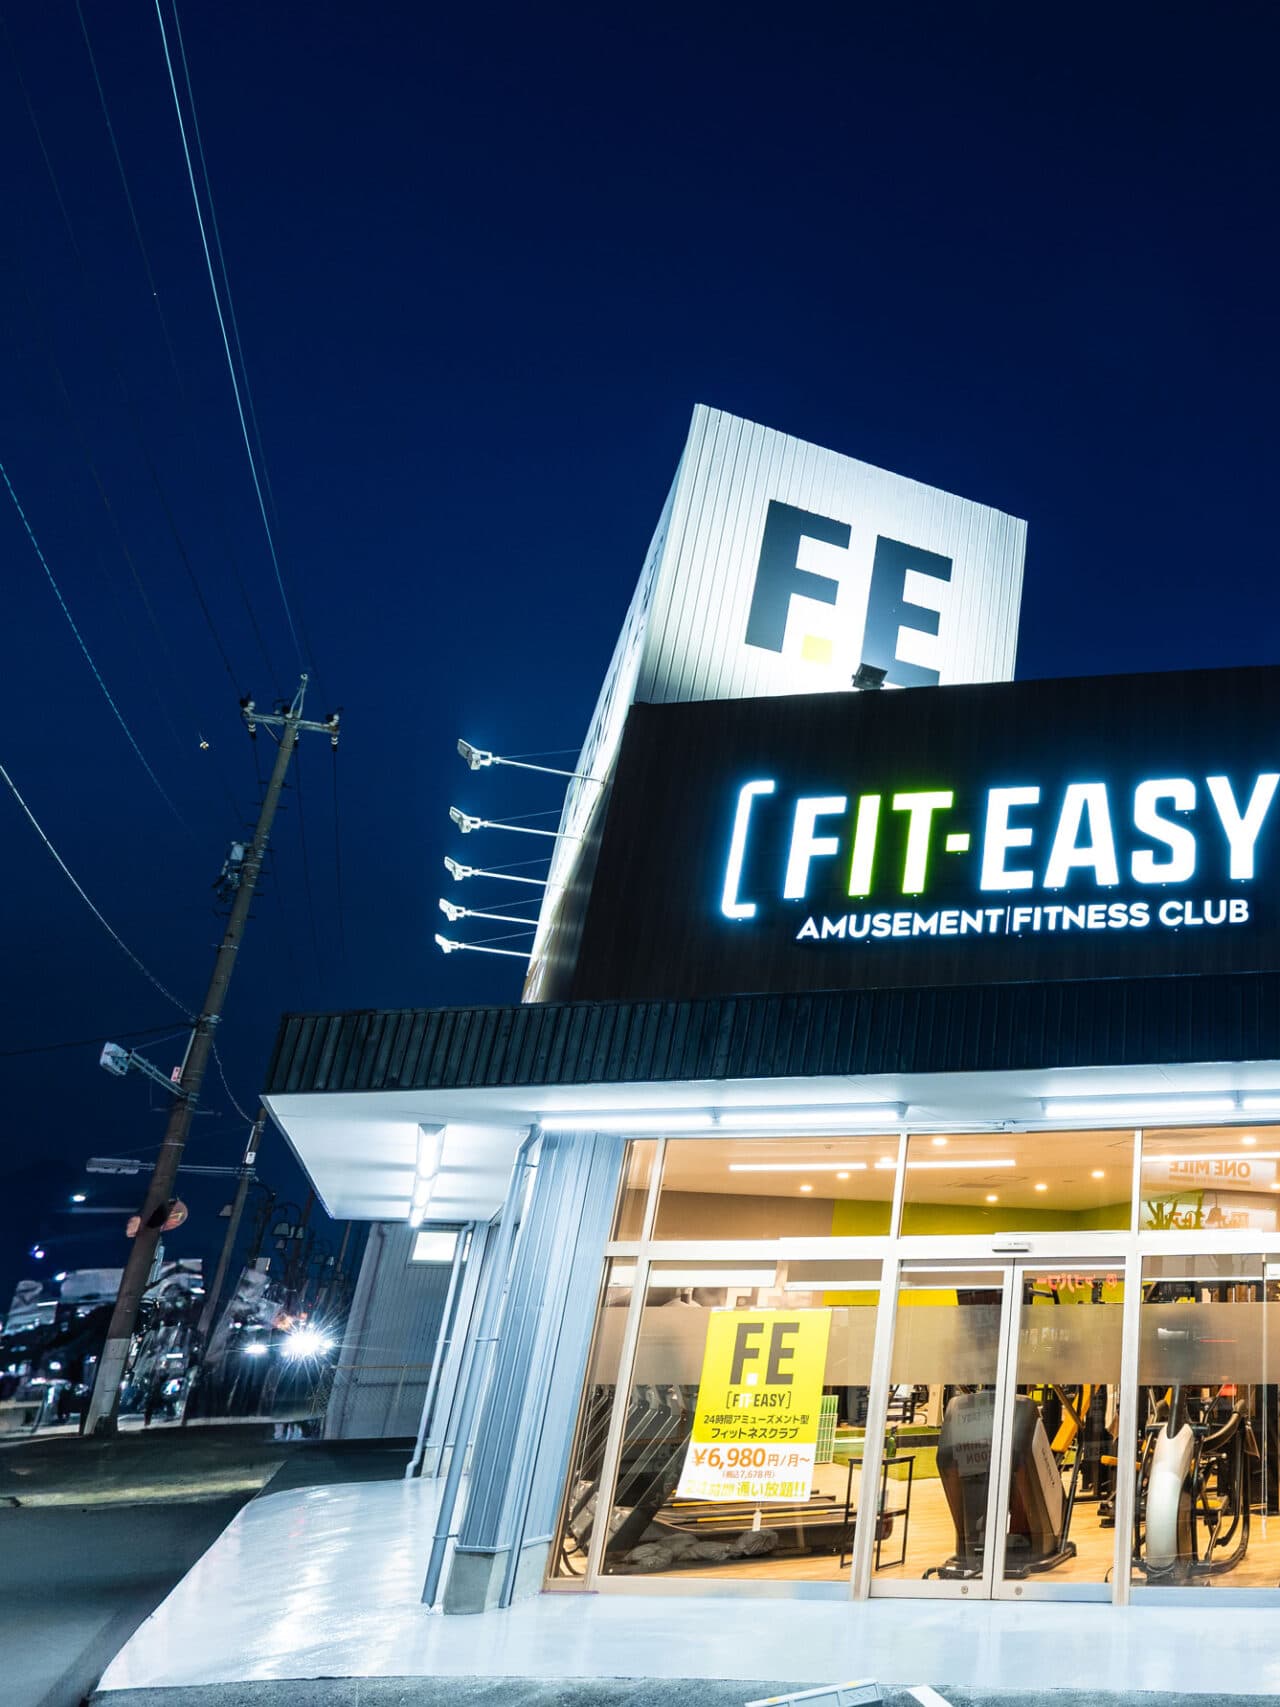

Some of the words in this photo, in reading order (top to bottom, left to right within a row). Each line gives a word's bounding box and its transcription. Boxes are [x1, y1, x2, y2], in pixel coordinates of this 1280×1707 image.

[1158, 899, 1250, 925] CLUB
[703, 1415, 809, 1425] 24時間アミューズメント型
[711, 1428, 798, 1439] フィットネスクラブ
